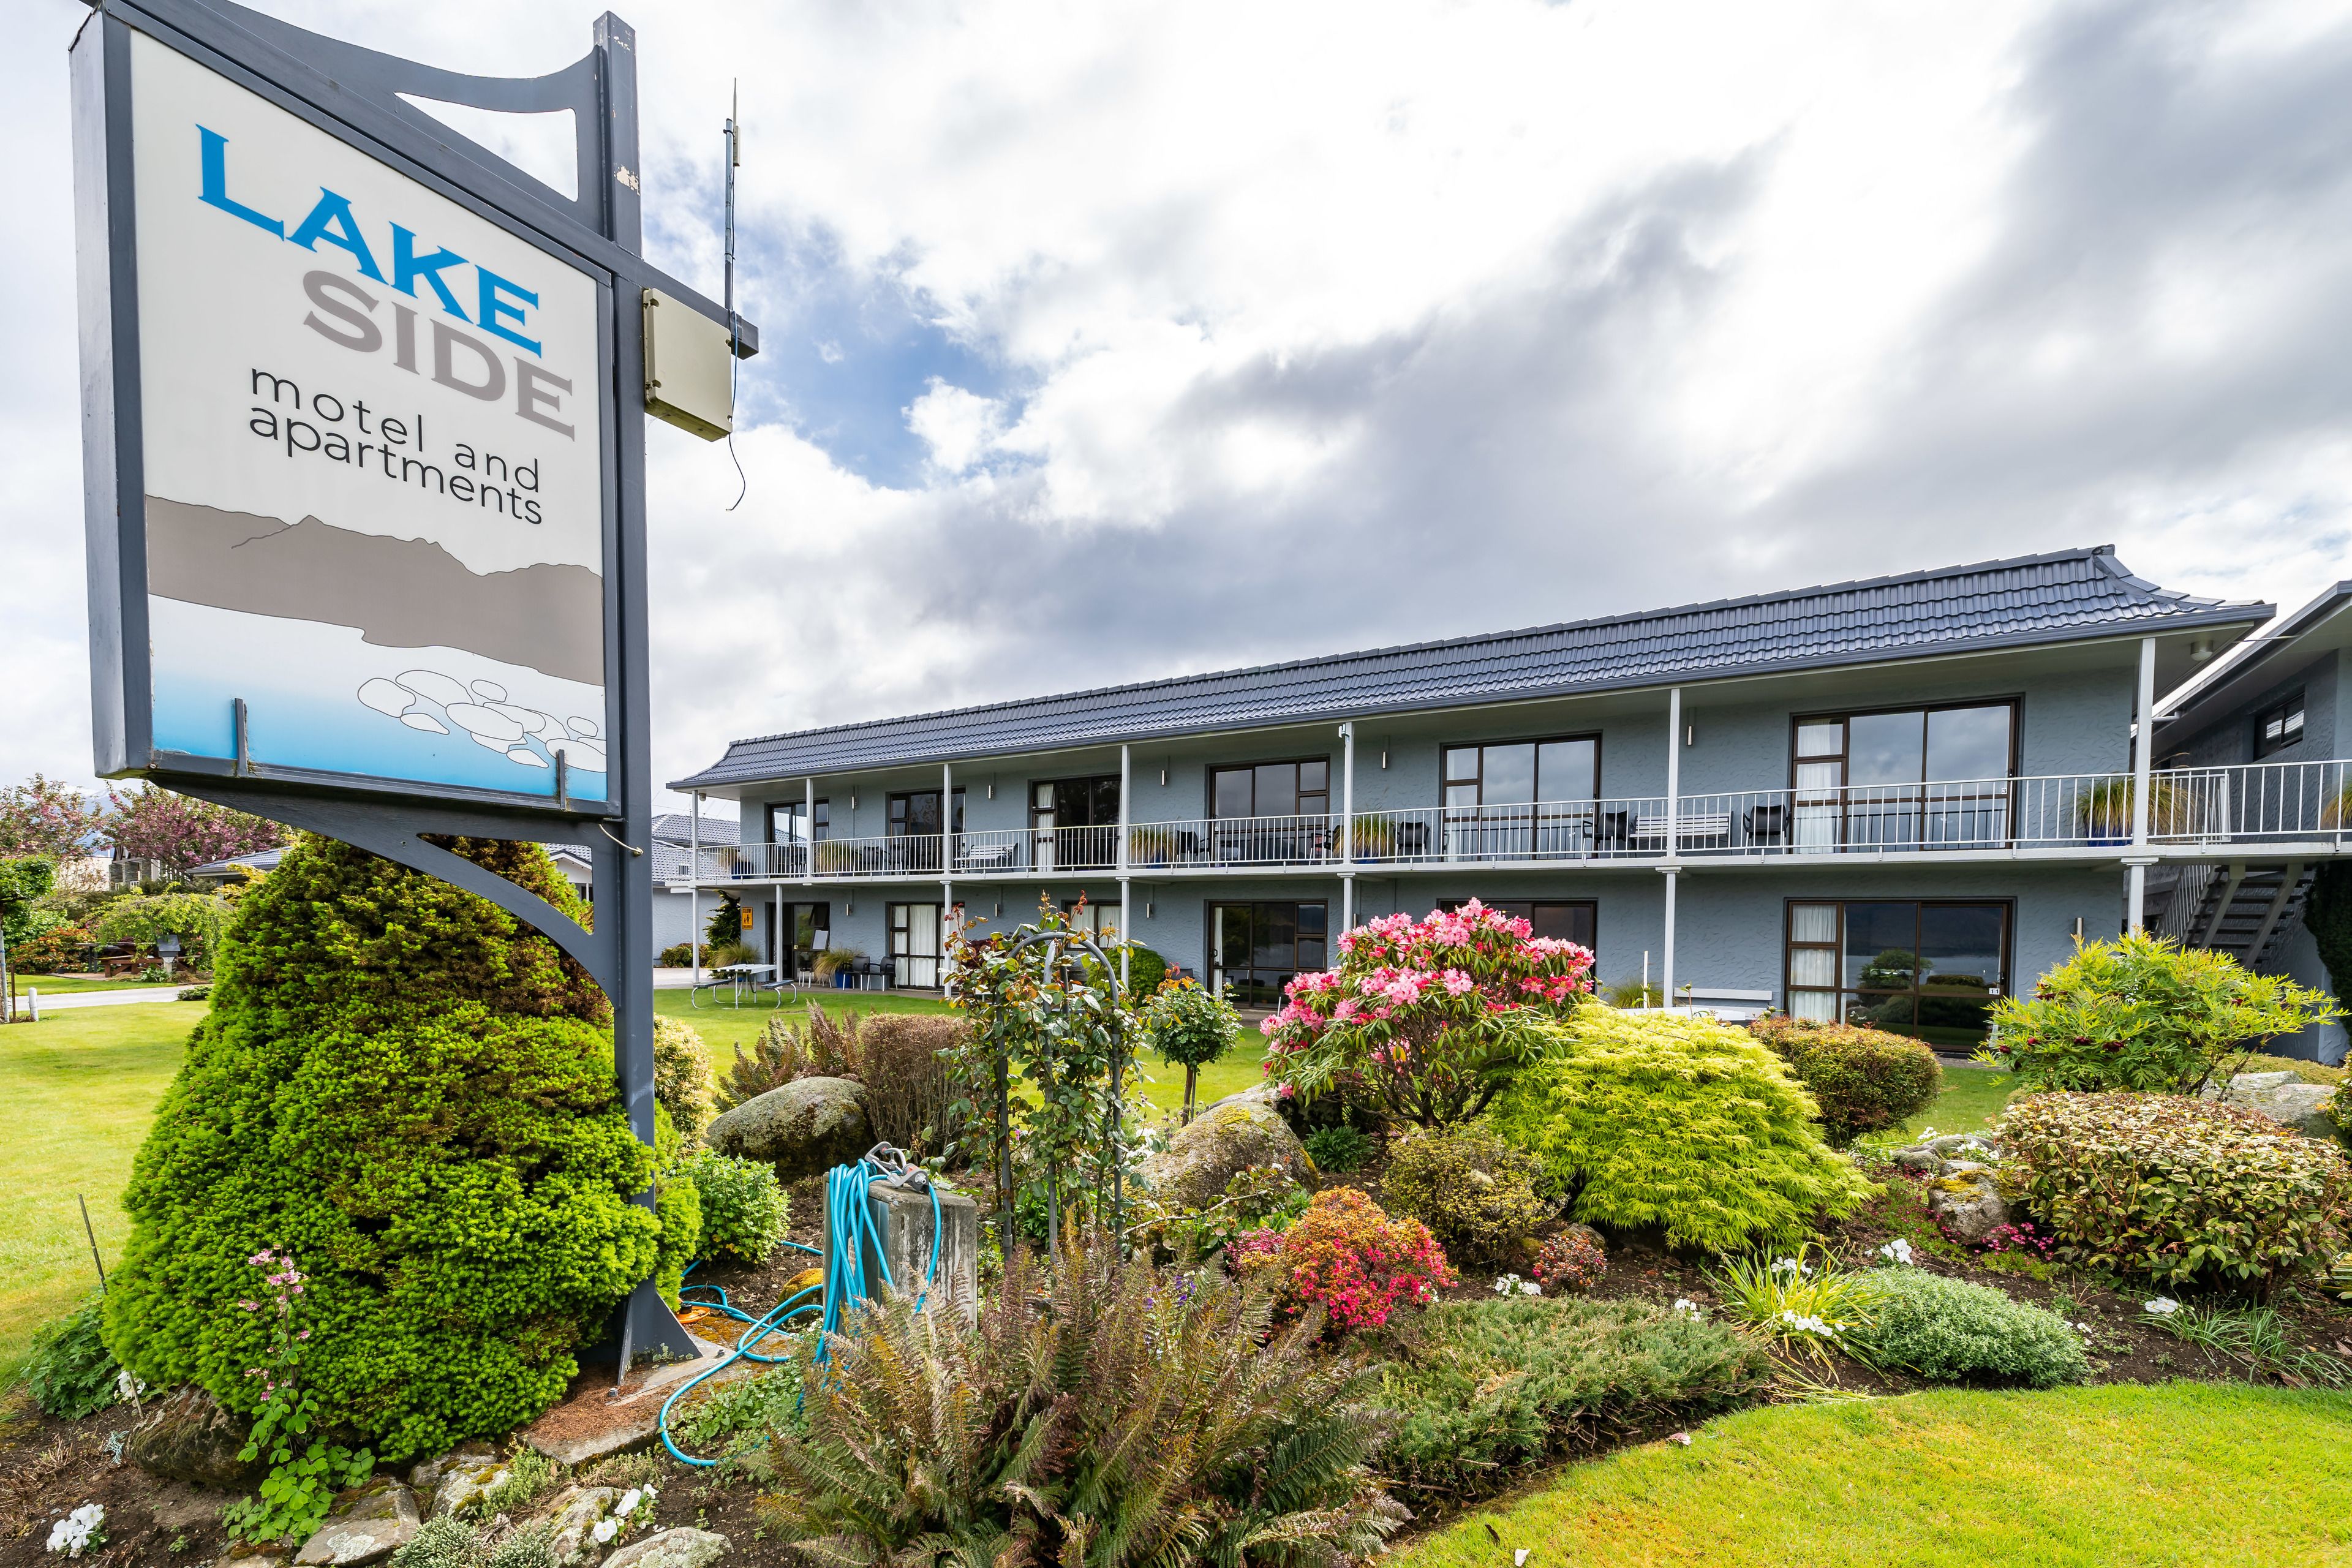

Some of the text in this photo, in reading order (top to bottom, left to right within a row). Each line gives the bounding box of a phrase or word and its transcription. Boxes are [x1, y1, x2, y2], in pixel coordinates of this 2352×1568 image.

[195, 124, 541, 358] LAKE
[252, 368, 538, 493] motel and
[303, 271, 575, 442] SIDE
[250, 407, 541, 524] apartments
